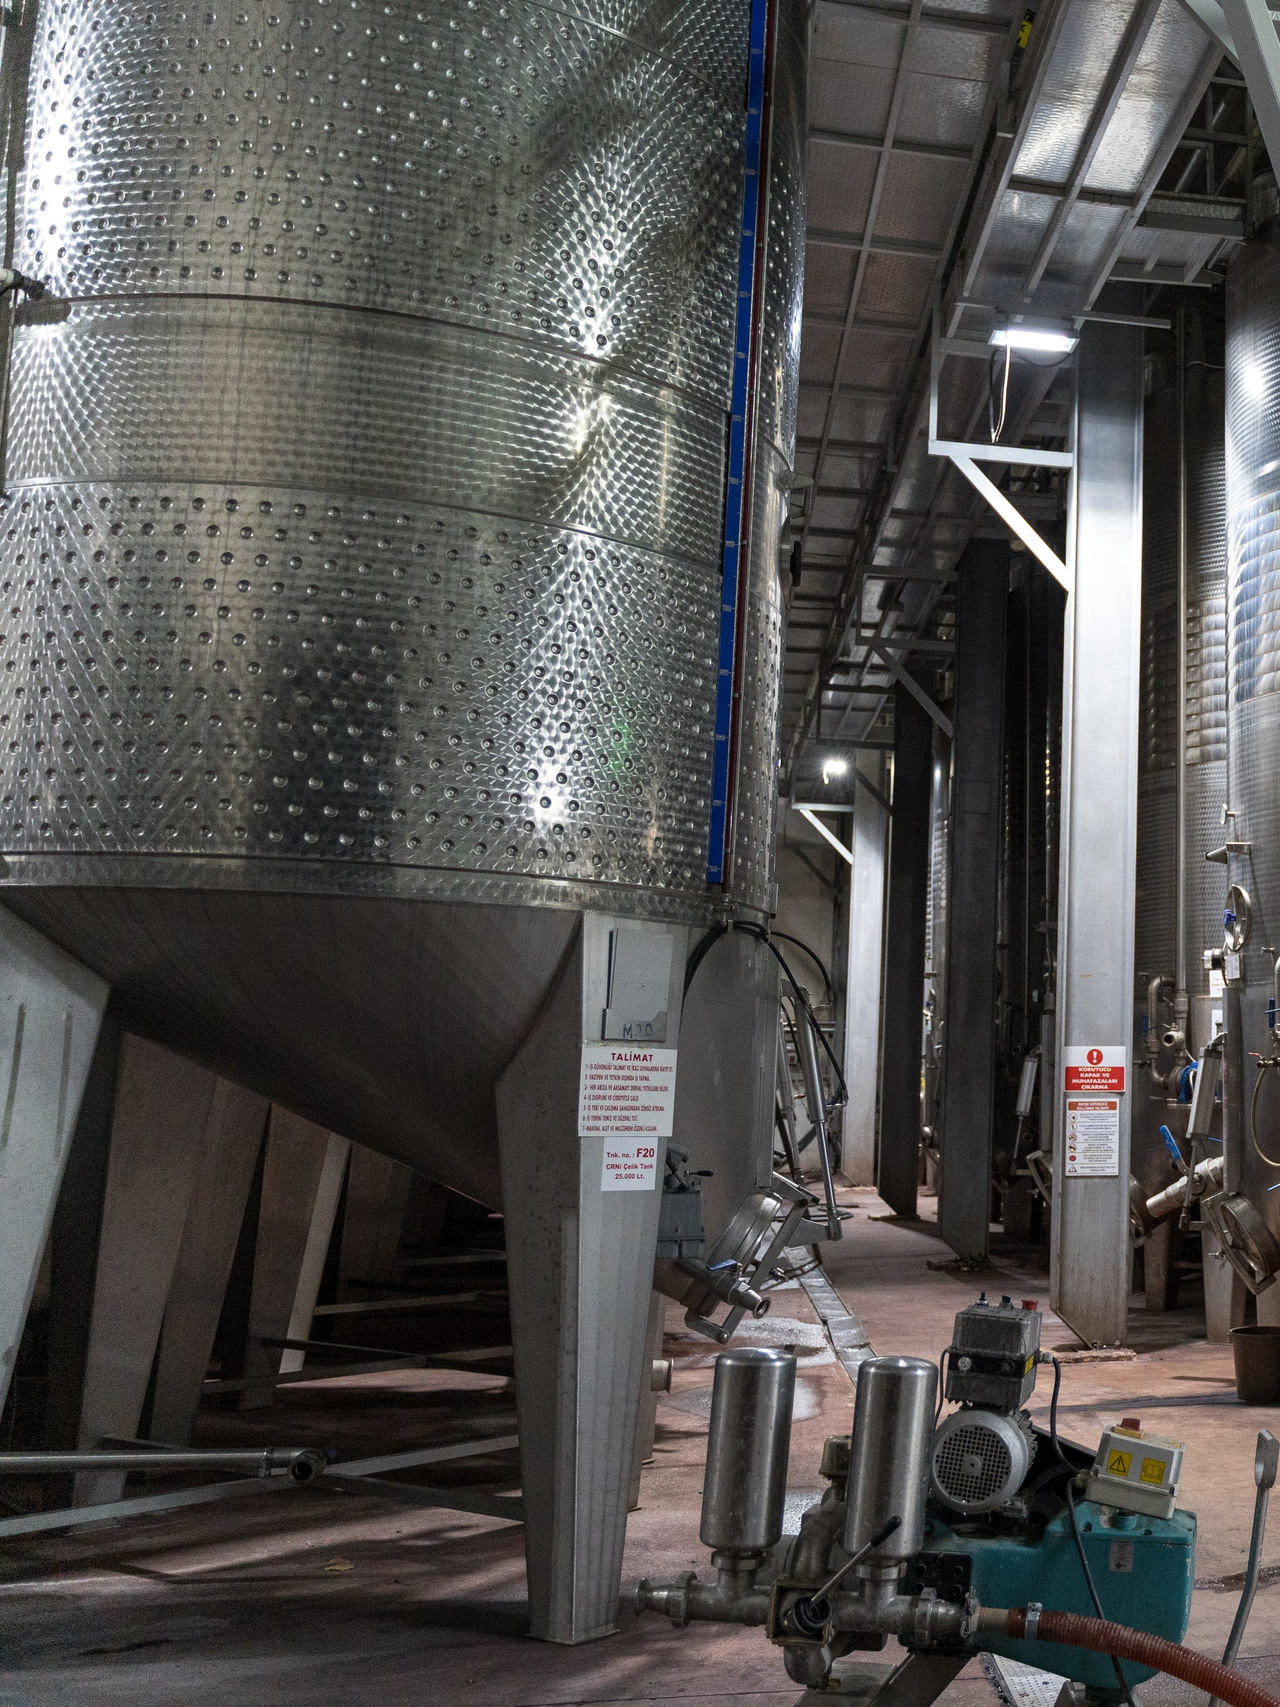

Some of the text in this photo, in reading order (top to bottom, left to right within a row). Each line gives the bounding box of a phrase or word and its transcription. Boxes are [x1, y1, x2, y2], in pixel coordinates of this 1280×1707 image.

[611, 1051, 653, 1062] TALİMAT
[613, 1063, 626, 1071] TALİMAT
[592, 1103, 600, 1111] YERİ
[637, 1148, 655, 1158] F20
[624, 1163, 639, 1171] Çelik
